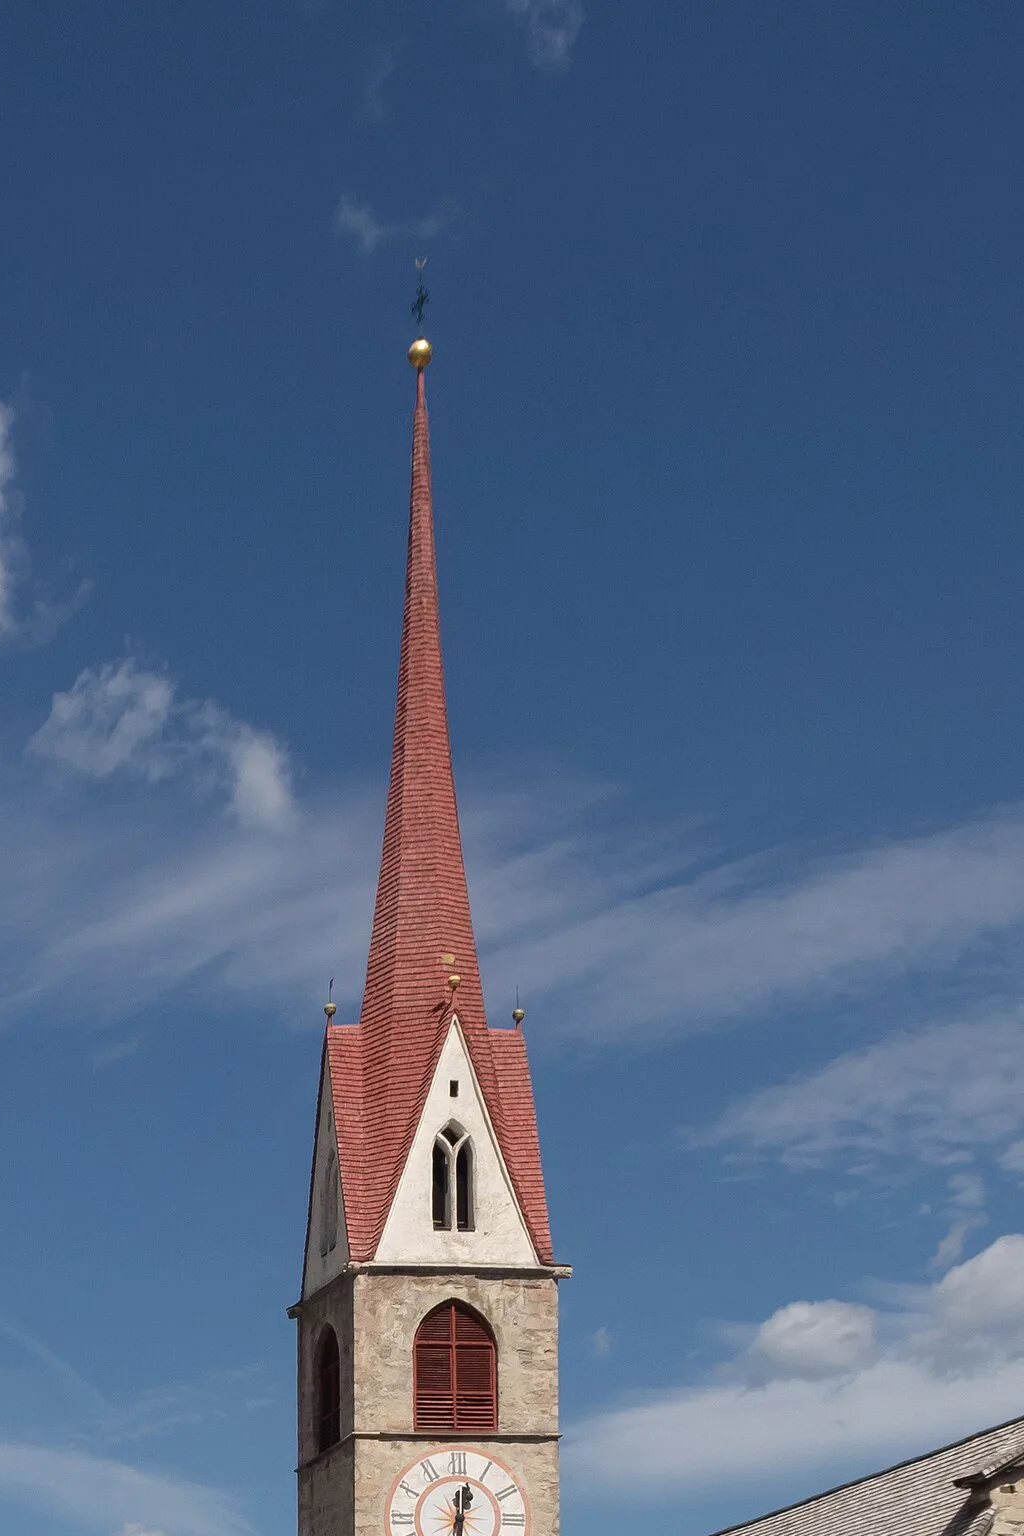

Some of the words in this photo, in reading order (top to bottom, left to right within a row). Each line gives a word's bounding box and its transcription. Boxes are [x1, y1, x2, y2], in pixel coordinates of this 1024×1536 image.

[420, 1458, 440, 1482] XI
[448, 1452, 467, 1475] XII
[479, 1461, 493, 1481] I
[495, 1484, 518, 1501] II
[502, 1513, 525, 1526] III
